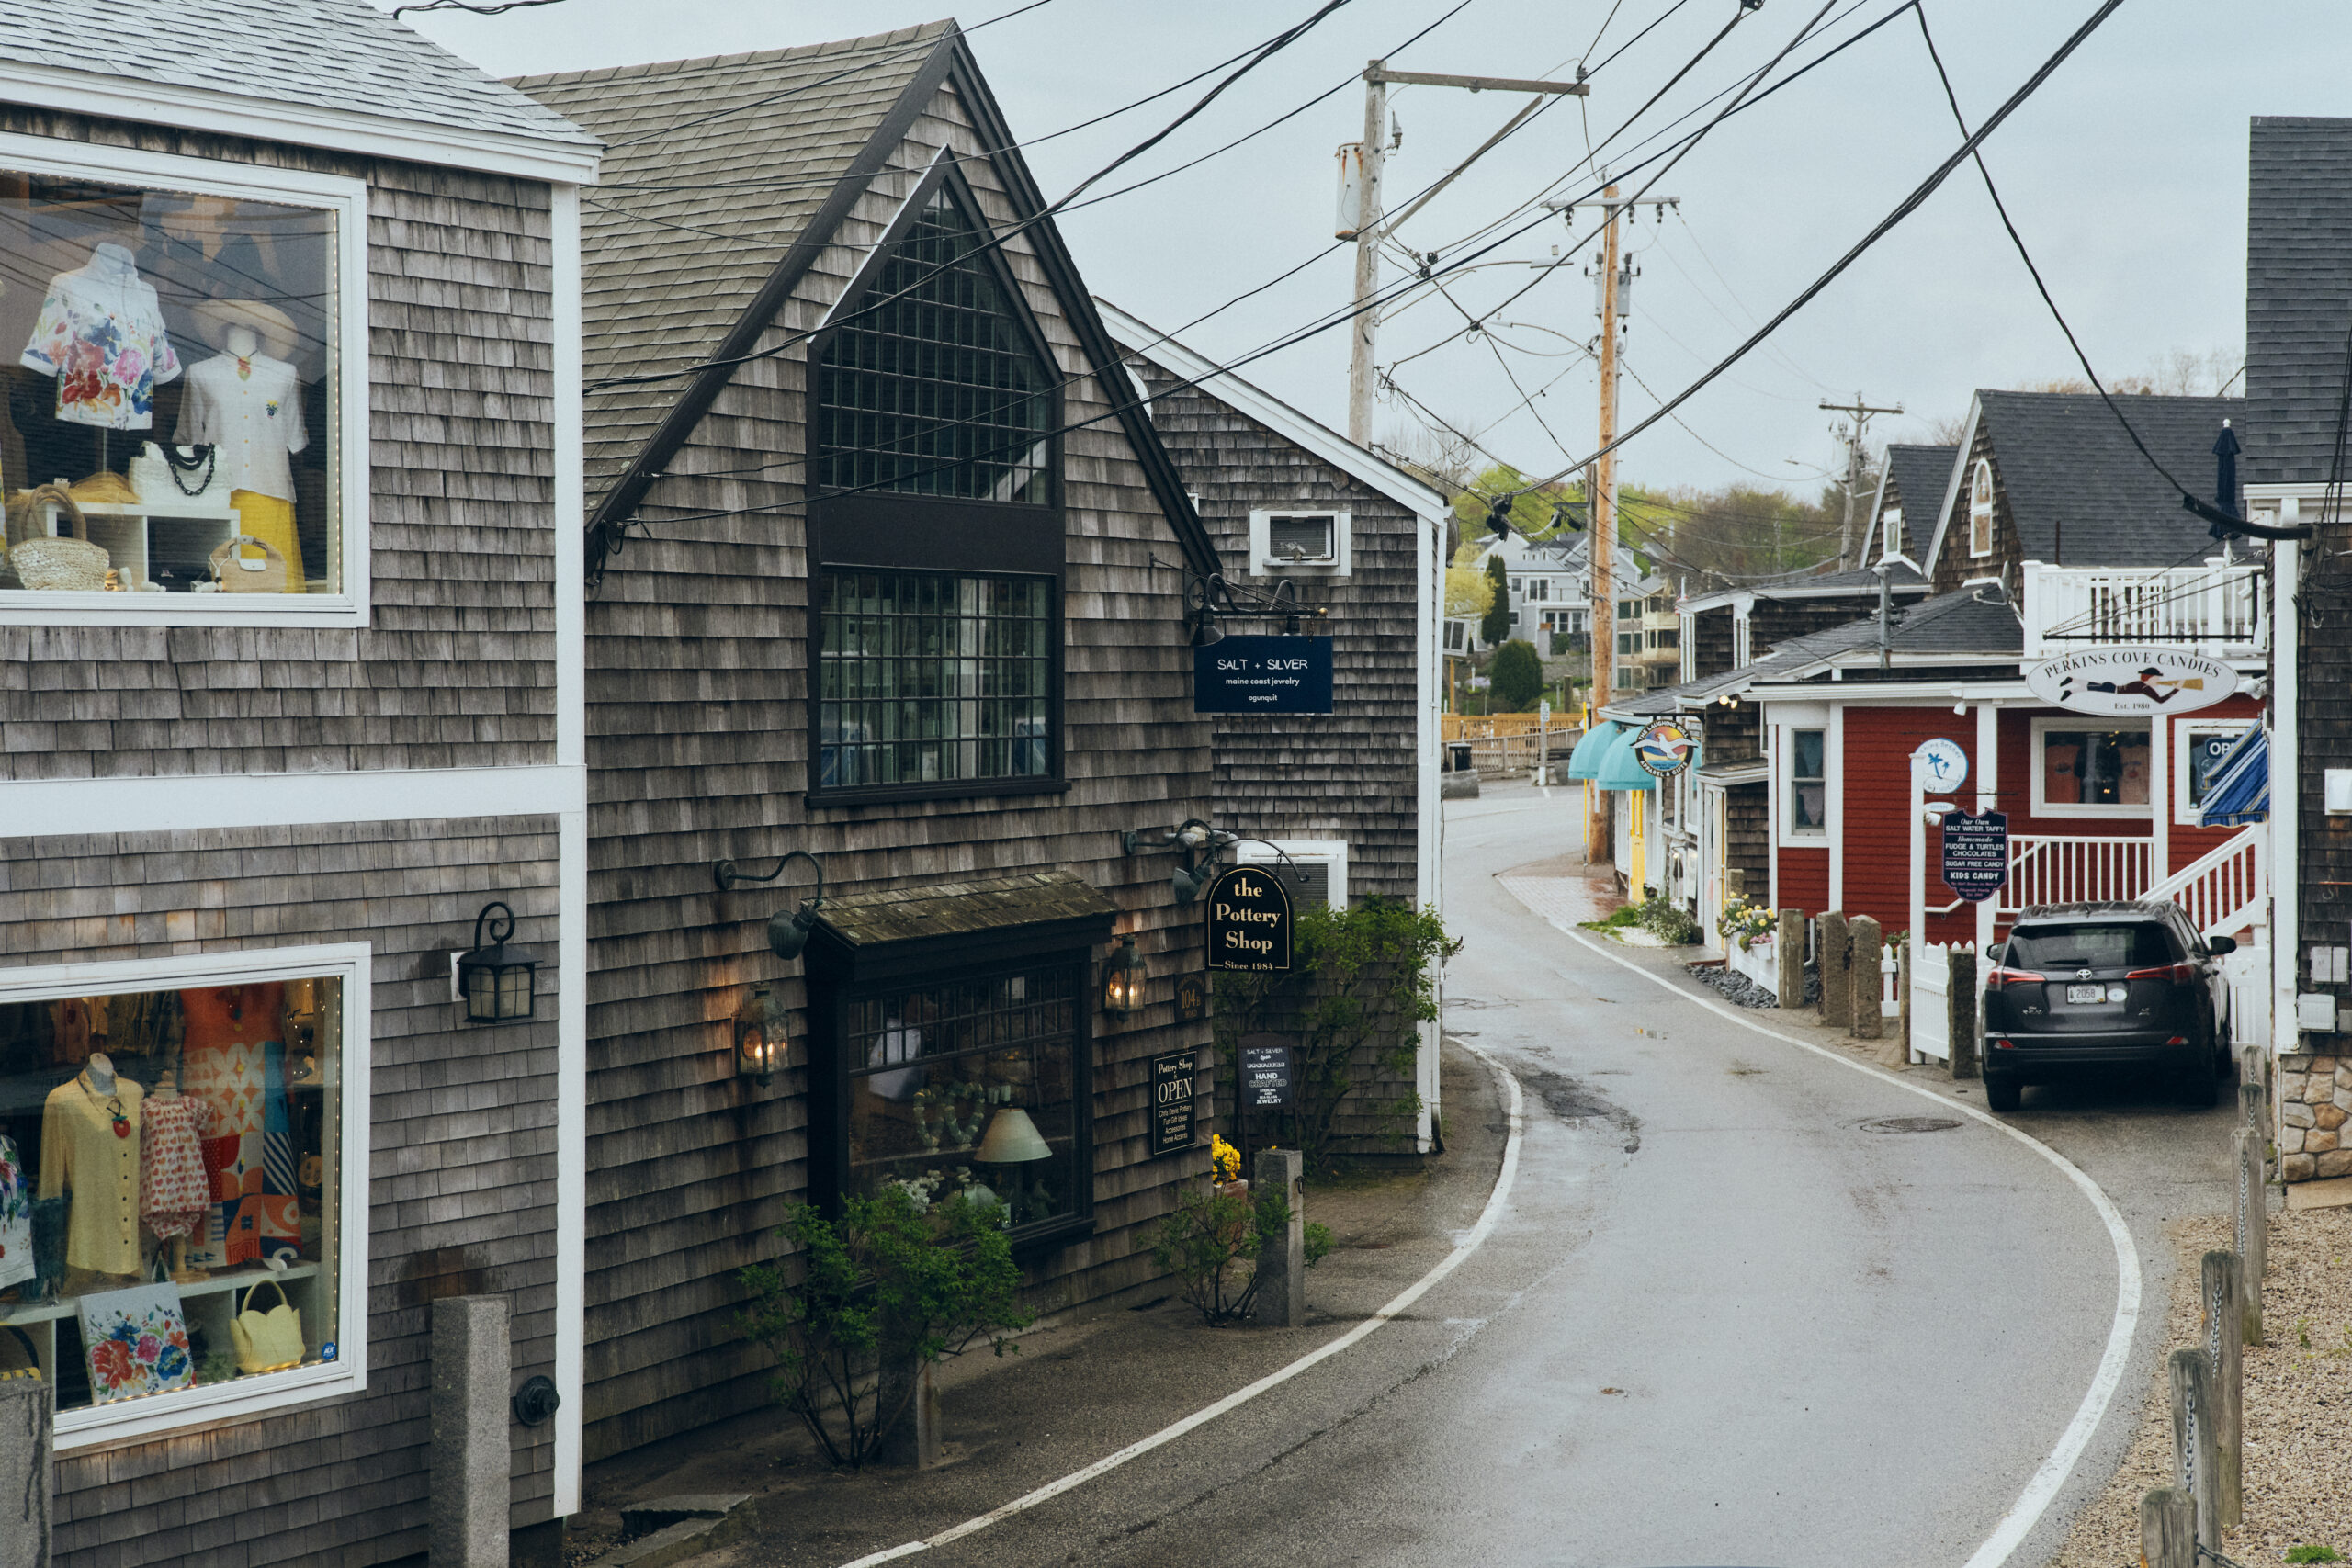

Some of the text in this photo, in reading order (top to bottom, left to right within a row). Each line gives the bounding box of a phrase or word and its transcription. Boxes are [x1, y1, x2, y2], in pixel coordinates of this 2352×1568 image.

[1217, 659, 1248, 671] SALT
[1267, 659, 1308, 670] SILVER
[2044, 652, 2222, 678] PERKINS COVE CANDIES
[1226, 677, 1249, 685] maine
[1272, 676, 1299, 687] jewelry
[1639, 720, 1689, 740] THE LAUGHING GULL
[2209, 742, 2236, 755] OP
[1640, 761, 1664, 776] APPAREL
[1672, 762, 1688, 775] GIFTS
[1950, 872, 1969, 880] KIDS
[1235, 878, 1262, 897] the
[1216, 904, 1281, 928] Pottery
[1226, 931, 1272, 954] Shop
[1224, 960, 1249, 970] Since
[2076, 989, 2095, 998] 2058
[1159, 1058, 1193, 1075] Pottery Shop
[1249, 1079, 1287, 1088] CRAFTED
[1158, 1077, 1193, 1103] OPEN
[1179, 1104, 1192, 1113] Pottery
[1165, 1124, 1186, 1134] Accessories
[1163, 1135, 1173, 1145] Home
